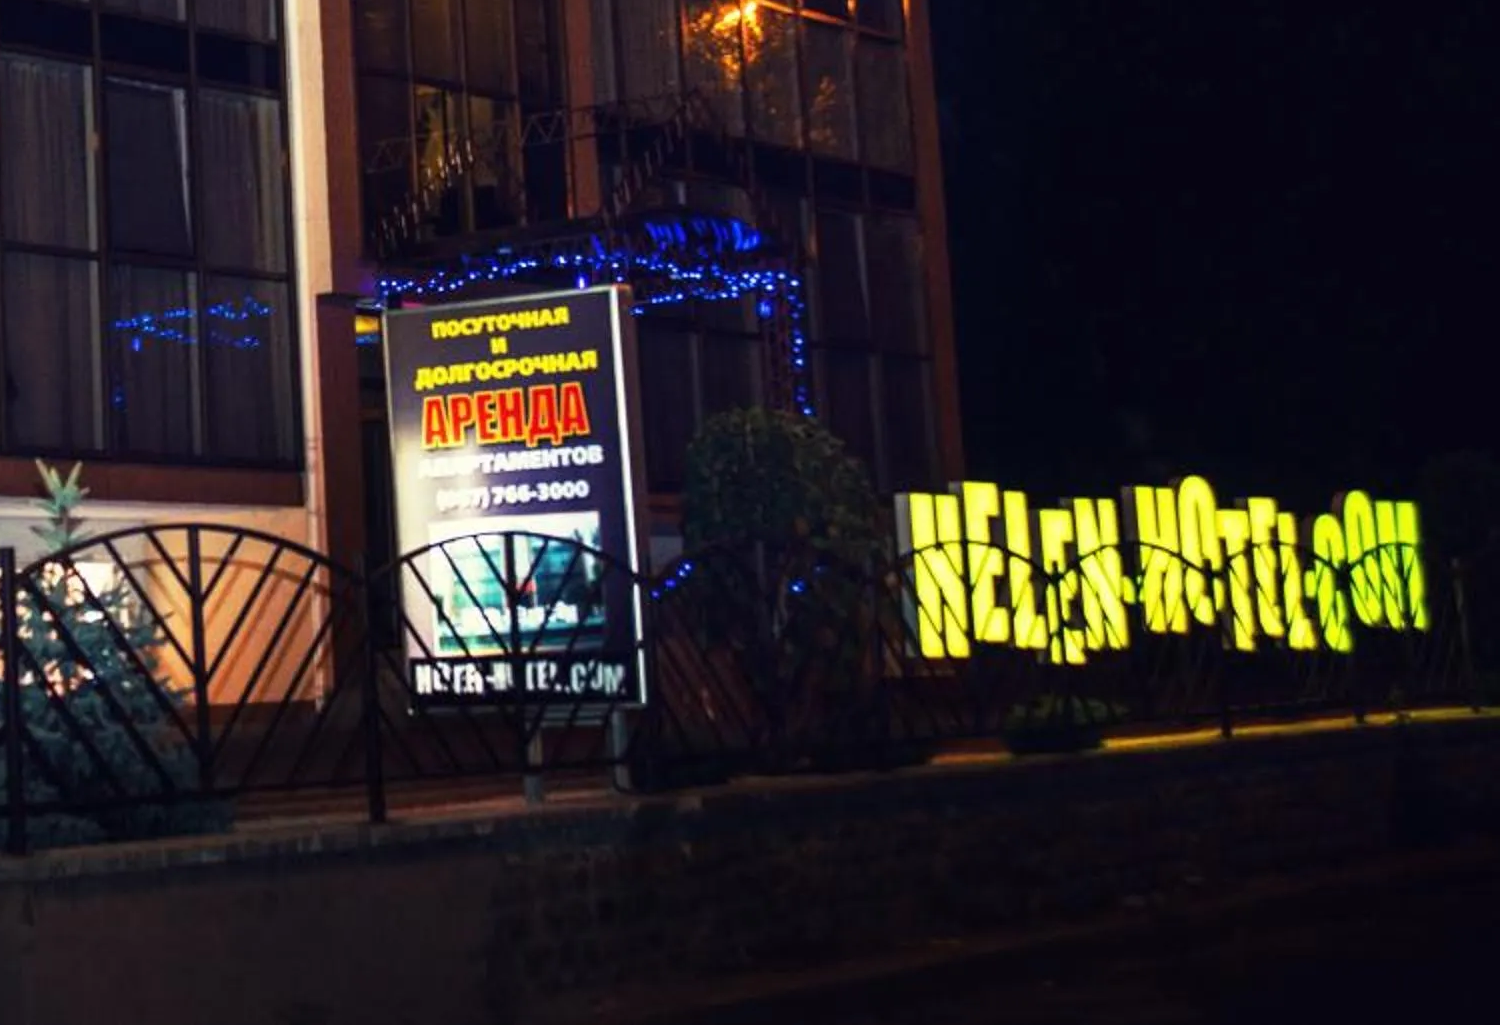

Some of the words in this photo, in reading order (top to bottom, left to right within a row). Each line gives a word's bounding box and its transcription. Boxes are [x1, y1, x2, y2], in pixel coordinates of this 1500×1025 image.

[431, 306, 570, 339] ПОСУТОЧНАЯ
[490, 336, 508, 355] И
[414, 350, 598, 391] ДОЛГОСРОЧНАЯ
[421, 381, 592, 449] АРЕНДА
